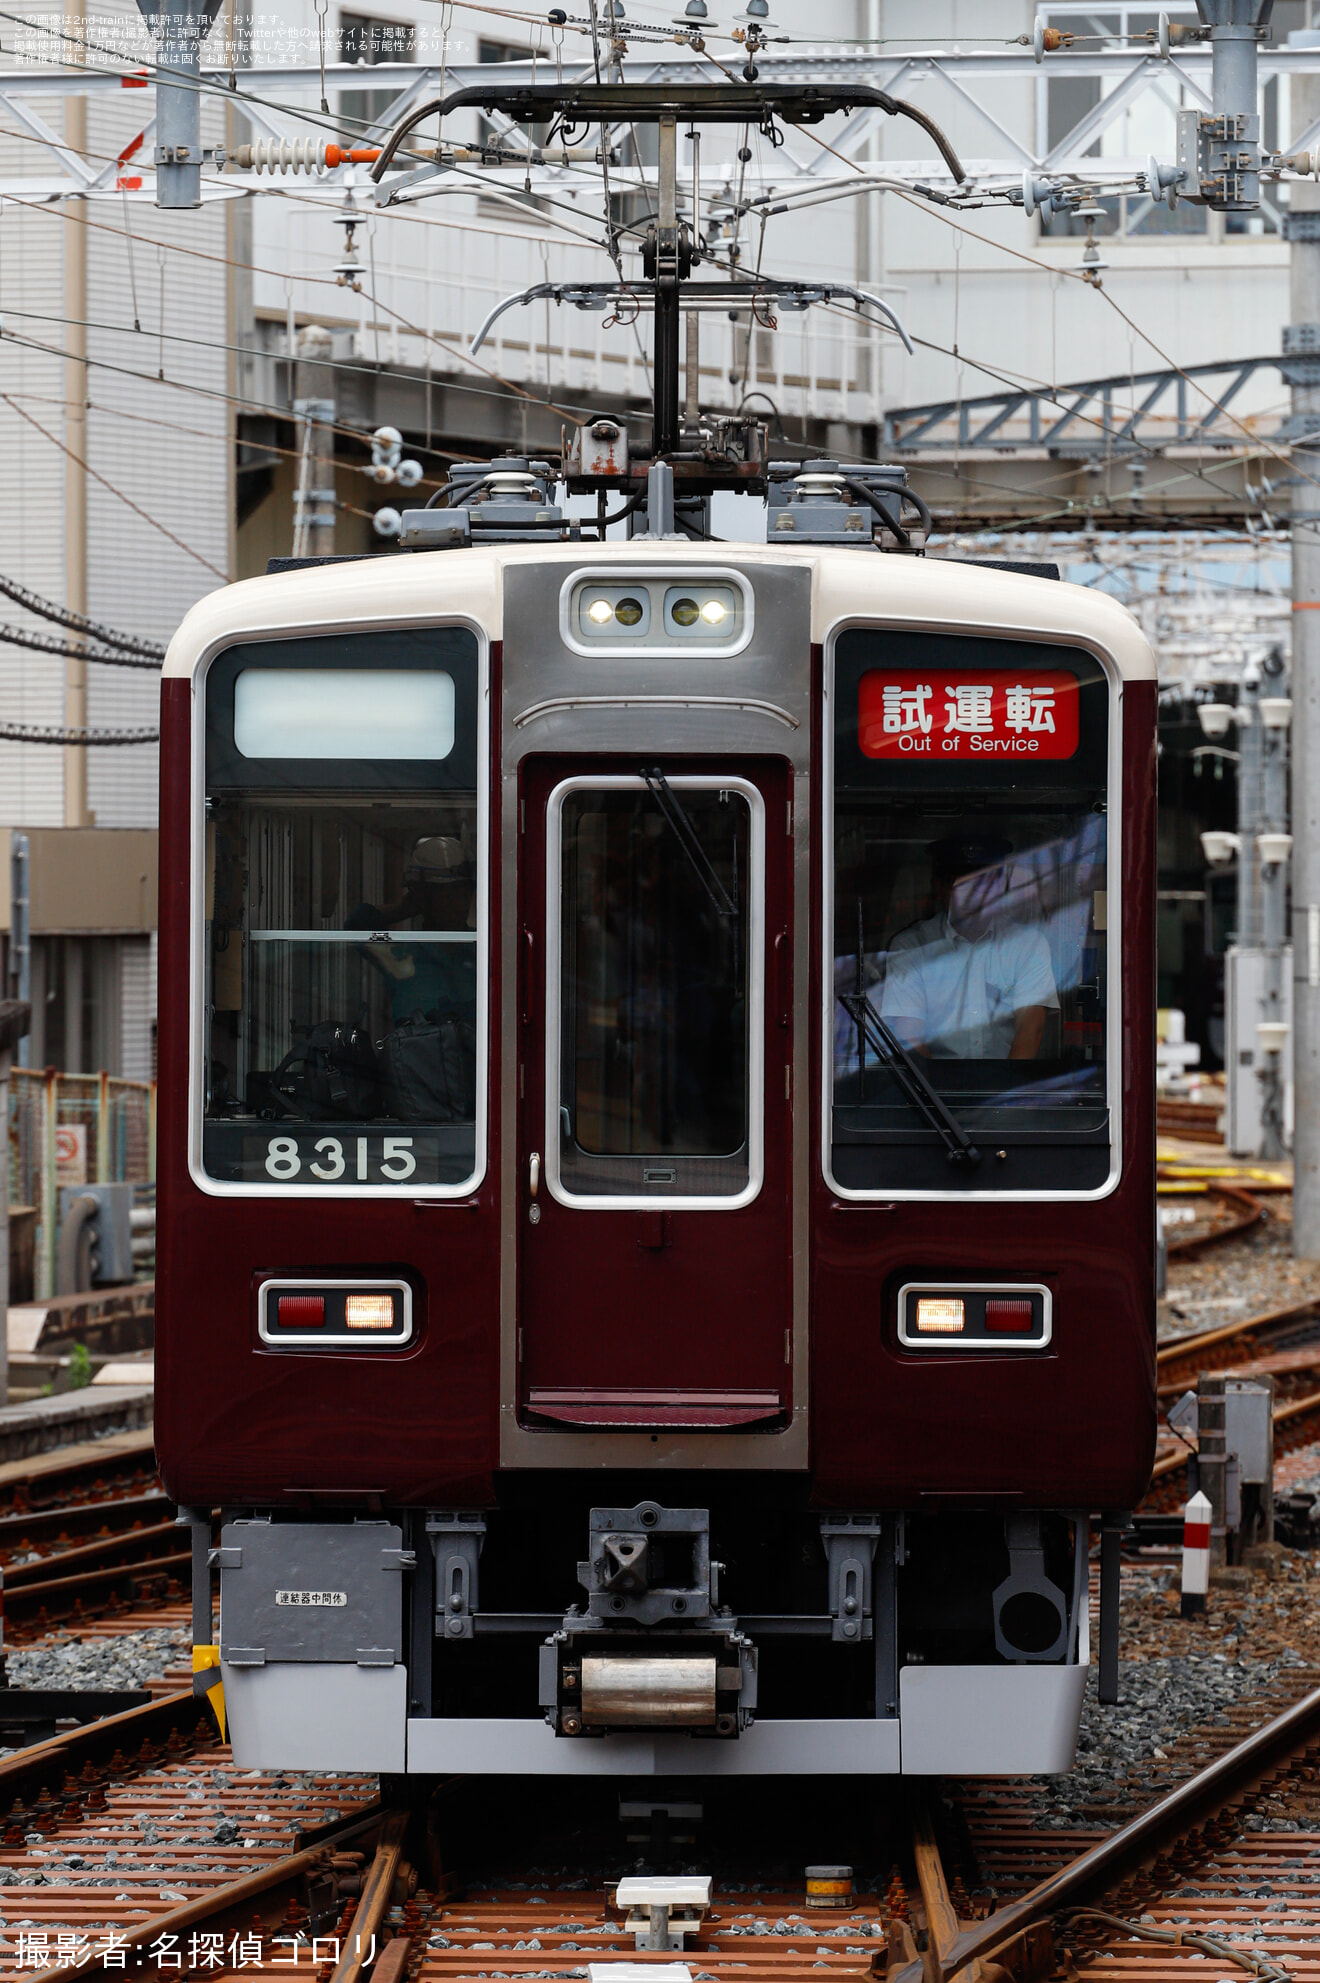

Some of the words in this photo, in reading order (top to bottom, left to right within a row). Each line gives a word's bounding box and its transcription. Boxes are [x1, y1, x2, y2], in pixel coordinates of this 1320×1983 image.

[882, 684, 1056, 733] 試運転
[898, 735, 931, 751] Out
[941, 735, 960, 751] of
[969, 735, 1039, 751] Service
[265, 1137, 416, 1180] 8315
